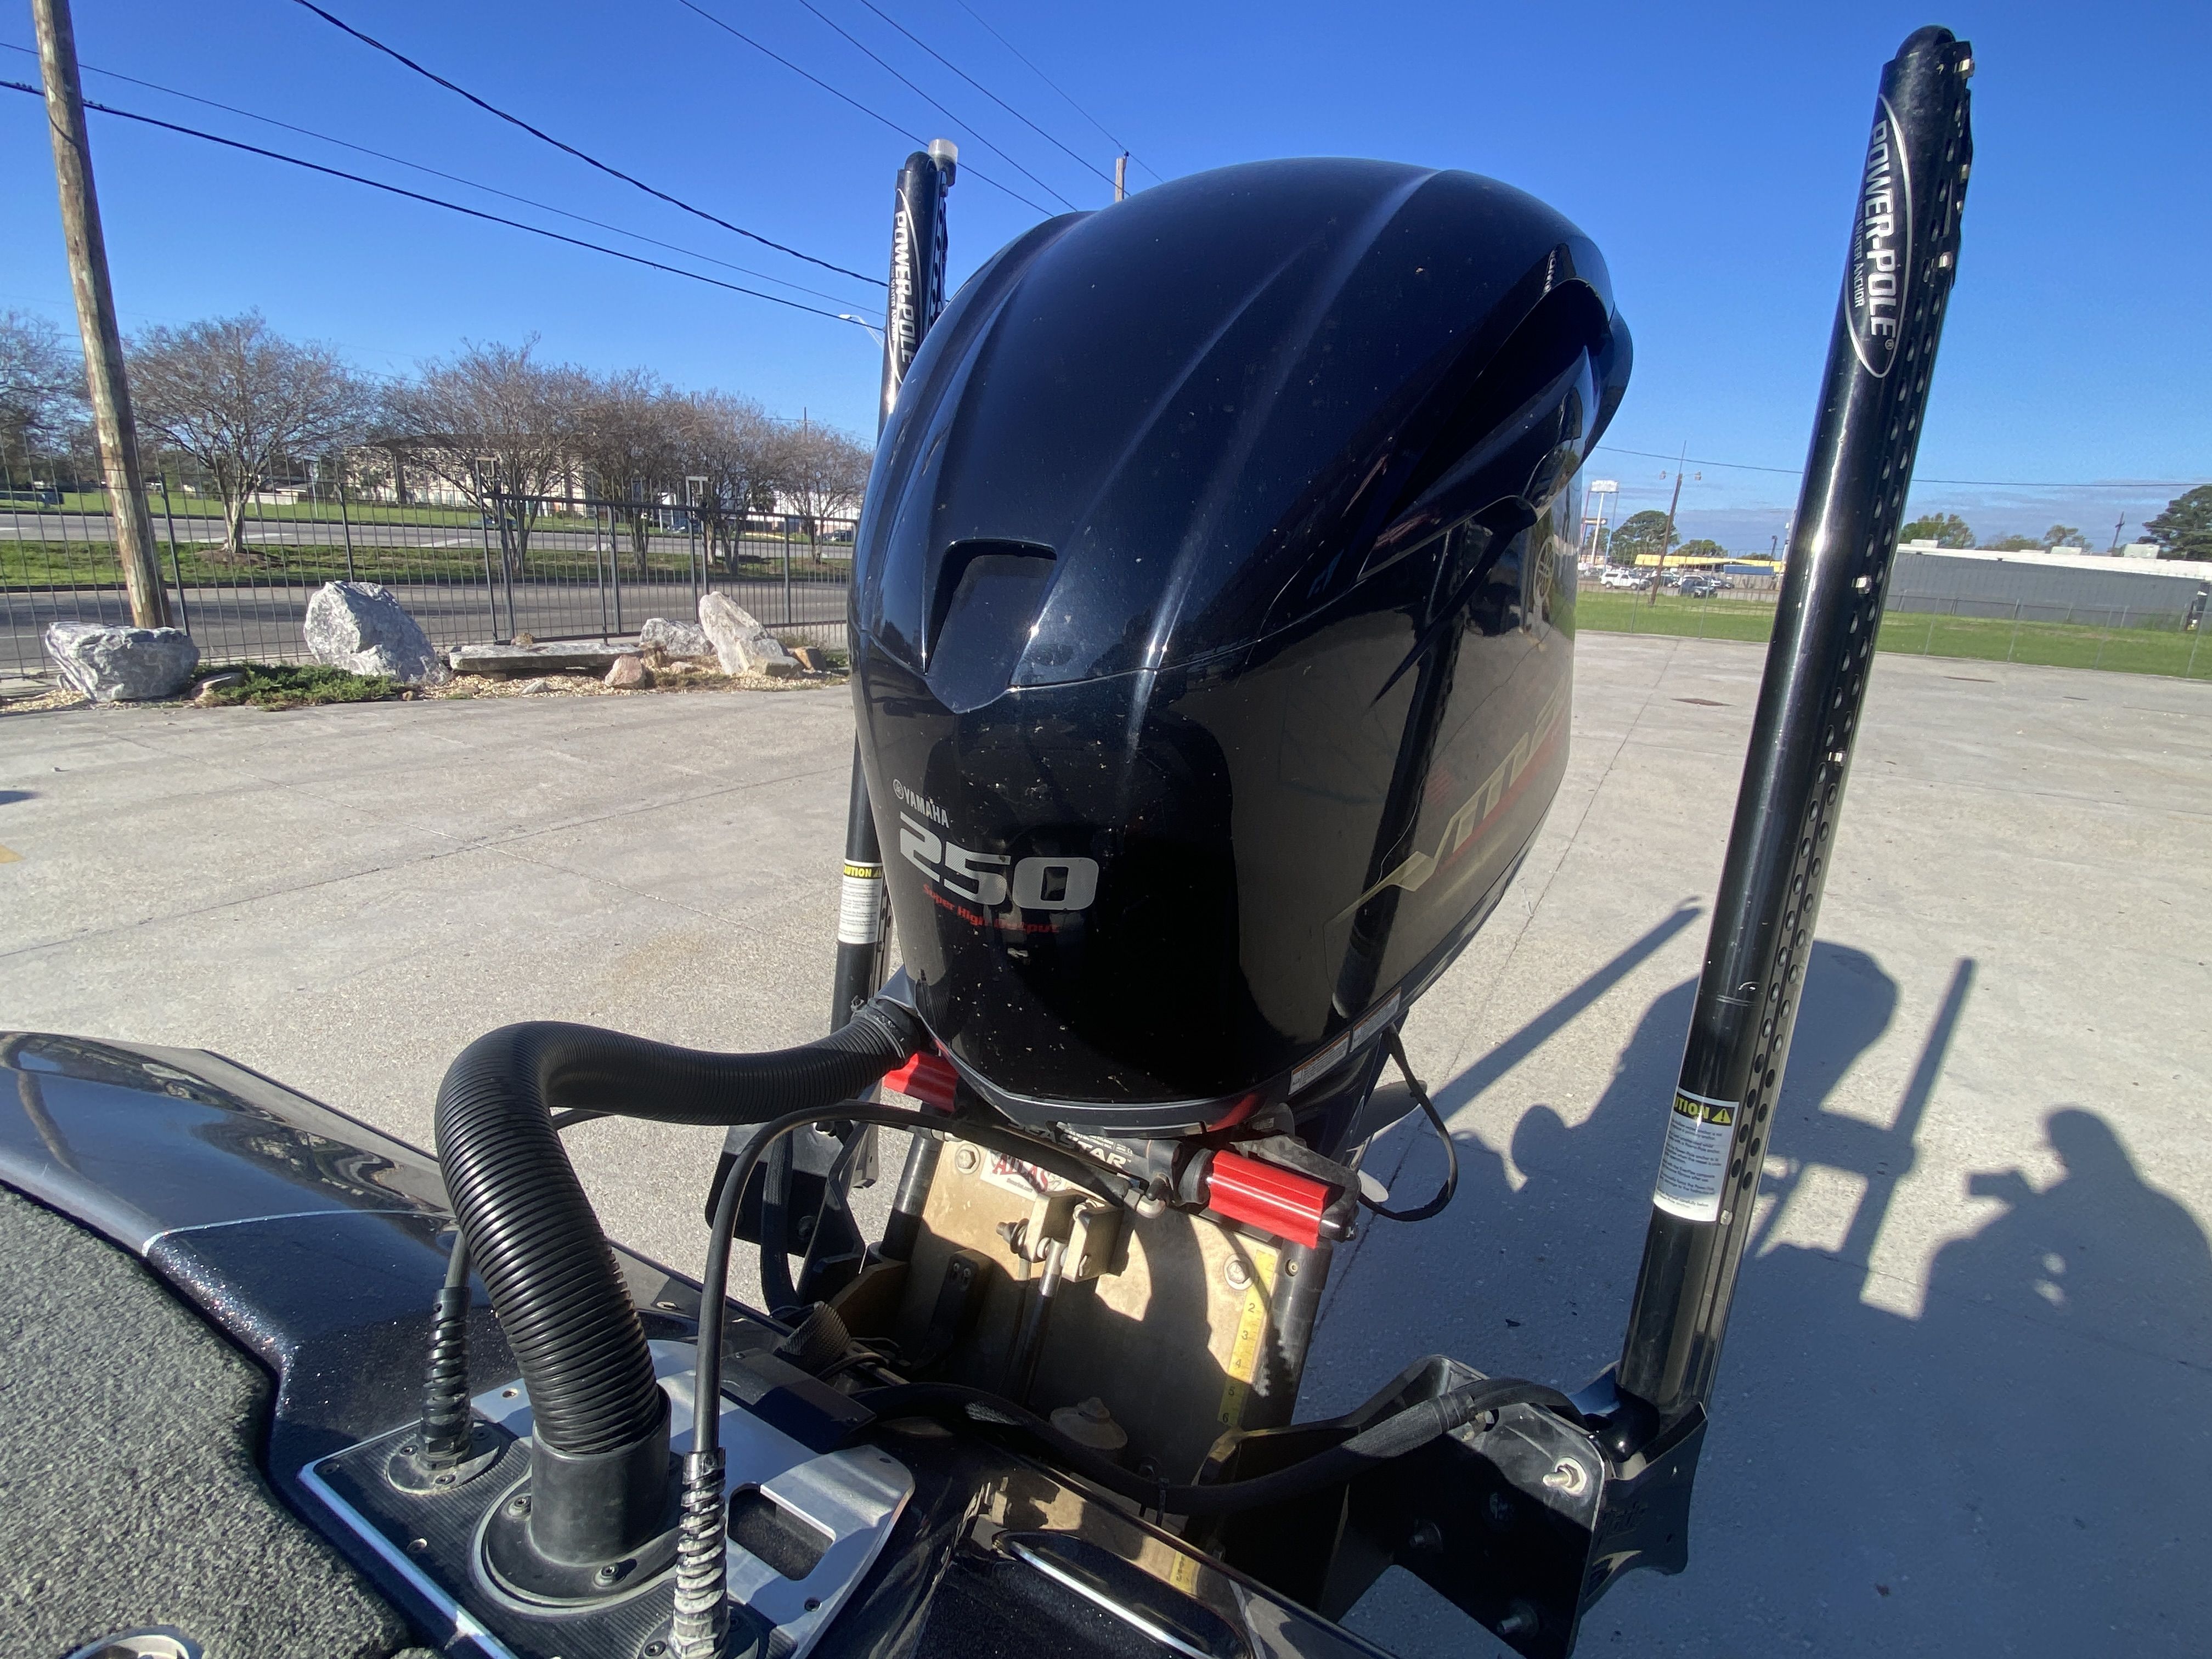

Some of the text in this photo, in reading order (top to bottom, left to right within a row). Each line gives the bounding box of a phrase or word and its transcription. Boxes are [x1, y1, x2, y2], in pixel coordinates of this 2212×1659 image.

[1854, 219, 1863, 261] WATER
[1854, 263, 1864, 308] ANCHOR
[903, 786, 950, 828] YAMAHA
[900, 811, 1099, 911] 250
[923, 883, 955, 911] Super
[956, 906, 991, 927] High
[1248, 1303, 1256, 1312] 2
[1241, 1330, 1249, 1340] 3
[1235, 1358, 1242, 1368] 4
[1228, 1387, 1235, 1396] 5
[1222, 1413, 1229, 1422] 6
